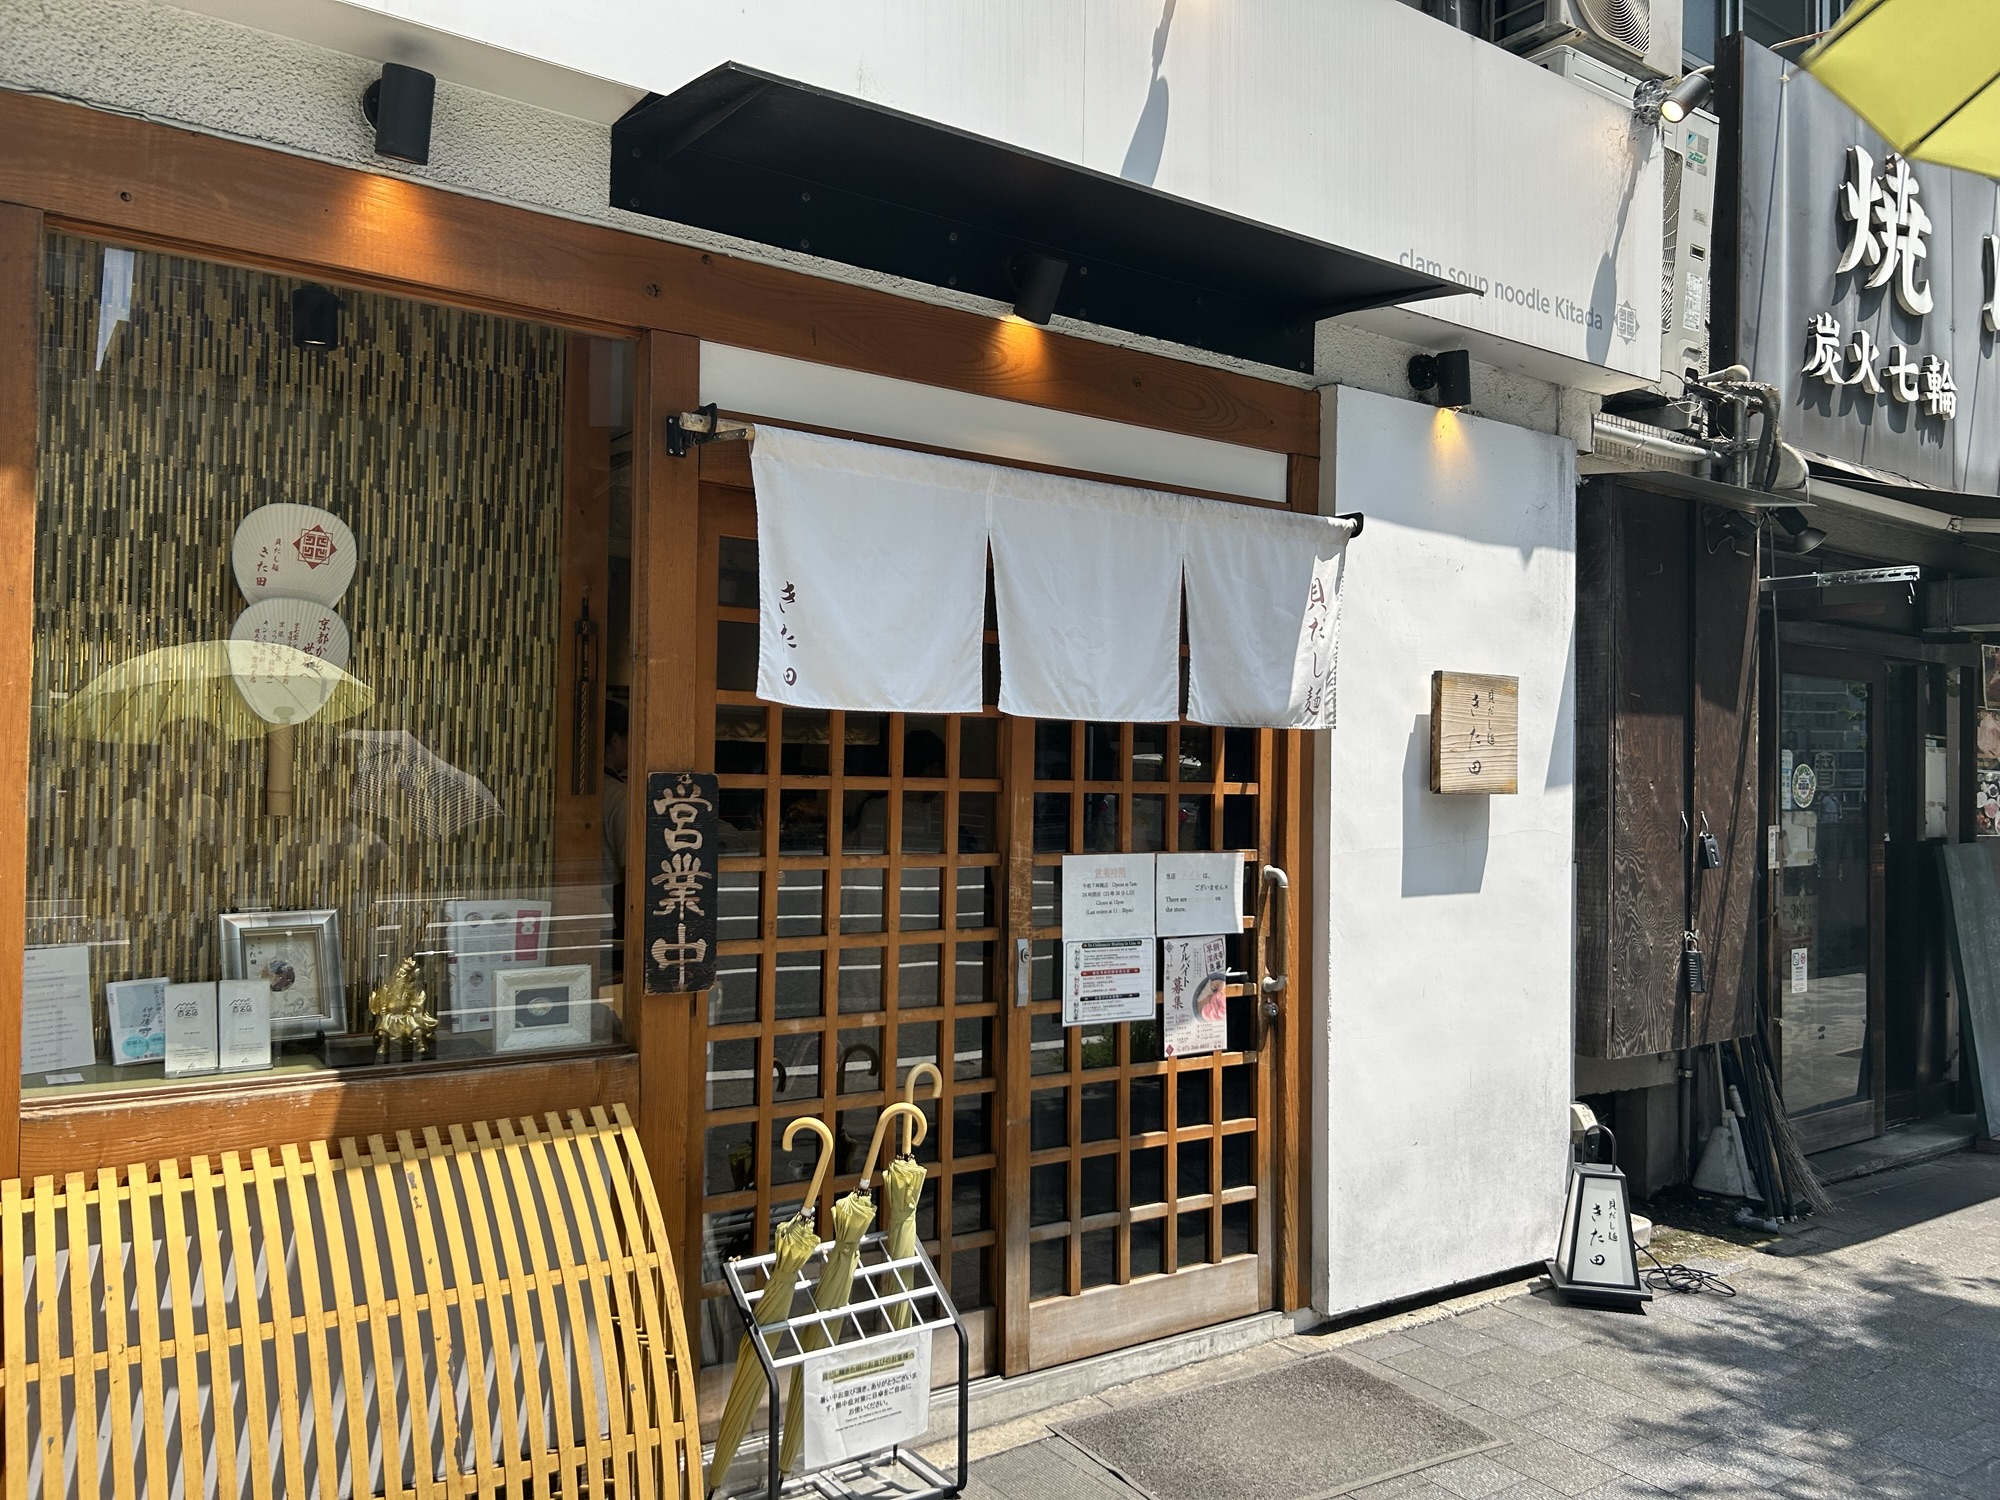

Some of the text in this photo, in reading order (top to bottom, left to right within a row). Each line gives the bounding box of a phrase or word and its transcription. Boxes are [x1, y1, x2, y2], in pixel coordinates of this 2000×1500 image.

[1399, 248, 1603, 331] clam soup noodle Kitada
[1801, 311, 1958, 422] 炭火七輪
[256, 546, 269, 586] きた田
[779, 580, 798, 686] きた田
[1304, 577, 1327, 715] 貝だし麺
[1468, 692, 1482, 775] きた田
[1487, 689, 1496, 745] 貝だし麺
[651, 783, 713, 992] 営業中
[1172, 976, 1184, 1010] 募集
[1180, 942, 1191, 987] アルバイト
[1589, 1203, 1605, 1266] きた田
[1608, 1198, 1618, 1242] 貝だし麺
